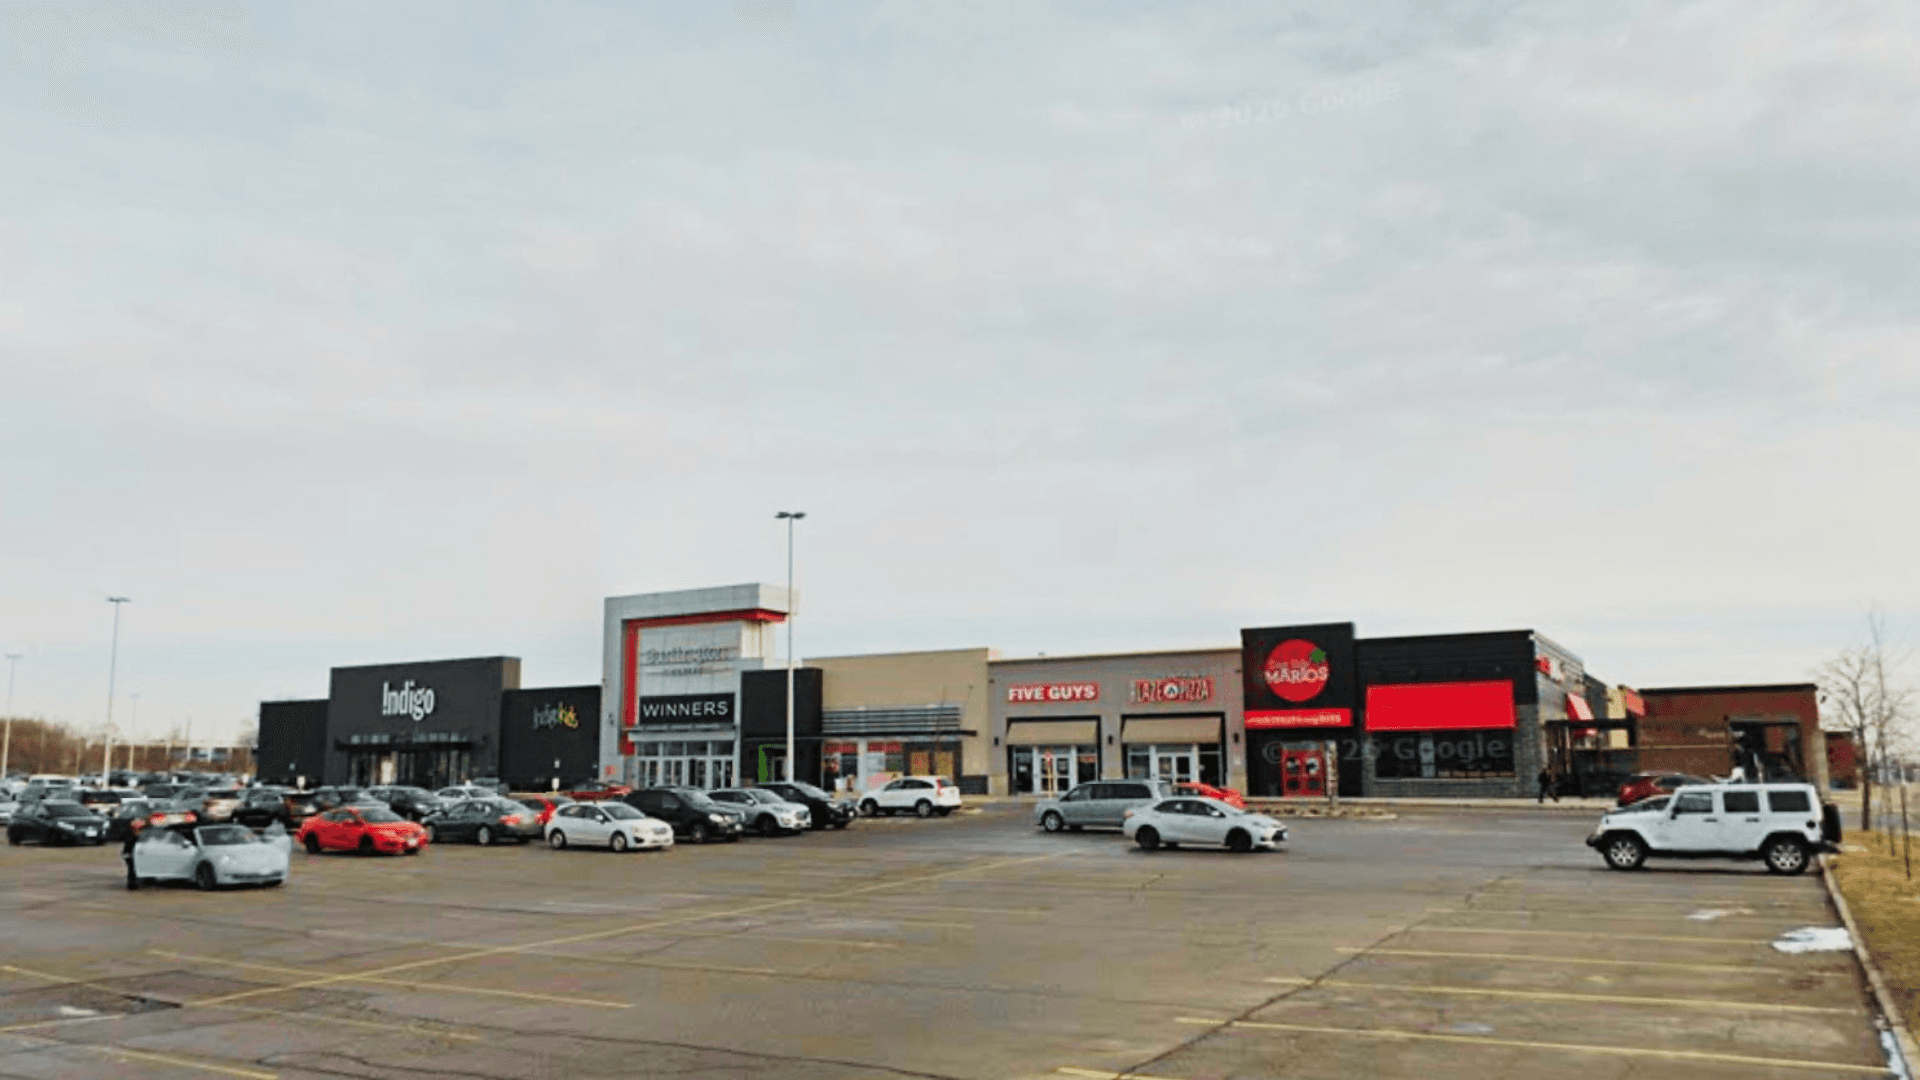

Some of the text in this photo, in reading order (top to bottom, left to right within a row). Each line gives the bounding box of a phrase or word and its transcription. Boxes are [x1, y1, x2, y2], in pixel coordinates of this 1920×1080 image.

[382, 679, 435, 721] Indigo
[1009, 683, 1096, 701] FIVE GUYS
[642, 700, 729, 718] WINNERS
